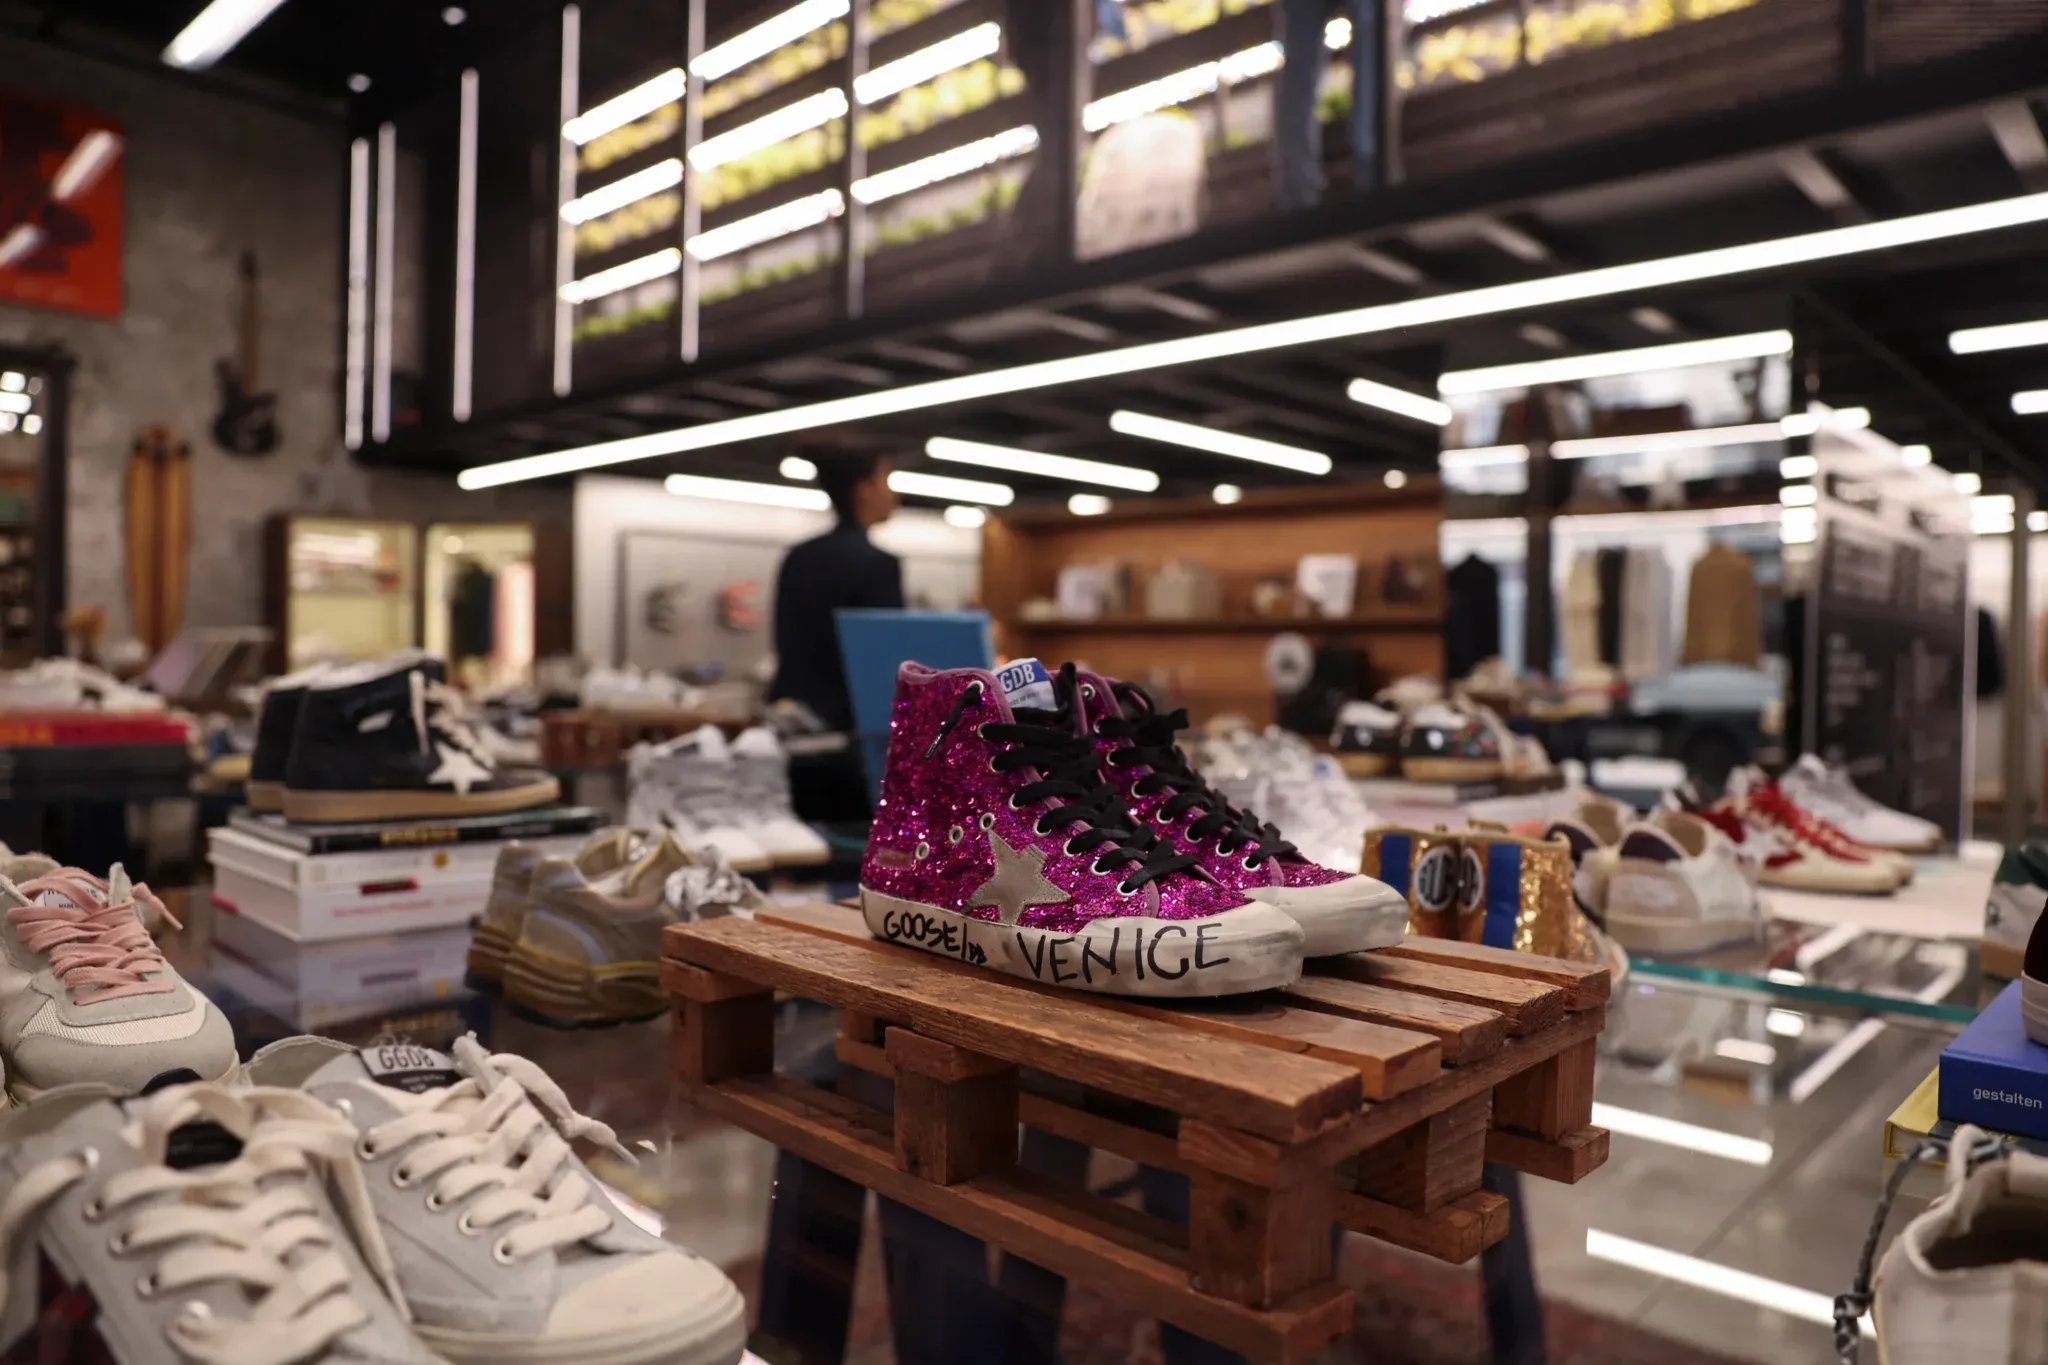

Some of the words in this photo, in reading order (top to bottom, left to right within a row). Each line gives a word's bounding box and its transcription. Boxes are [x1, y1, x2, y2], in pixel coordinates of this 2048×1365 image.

[1000, 663, 1035, 692] GDB
[1016, 923, 1229, 983] VENICE
[1973, 1088, 2042, 1109] gestalten
